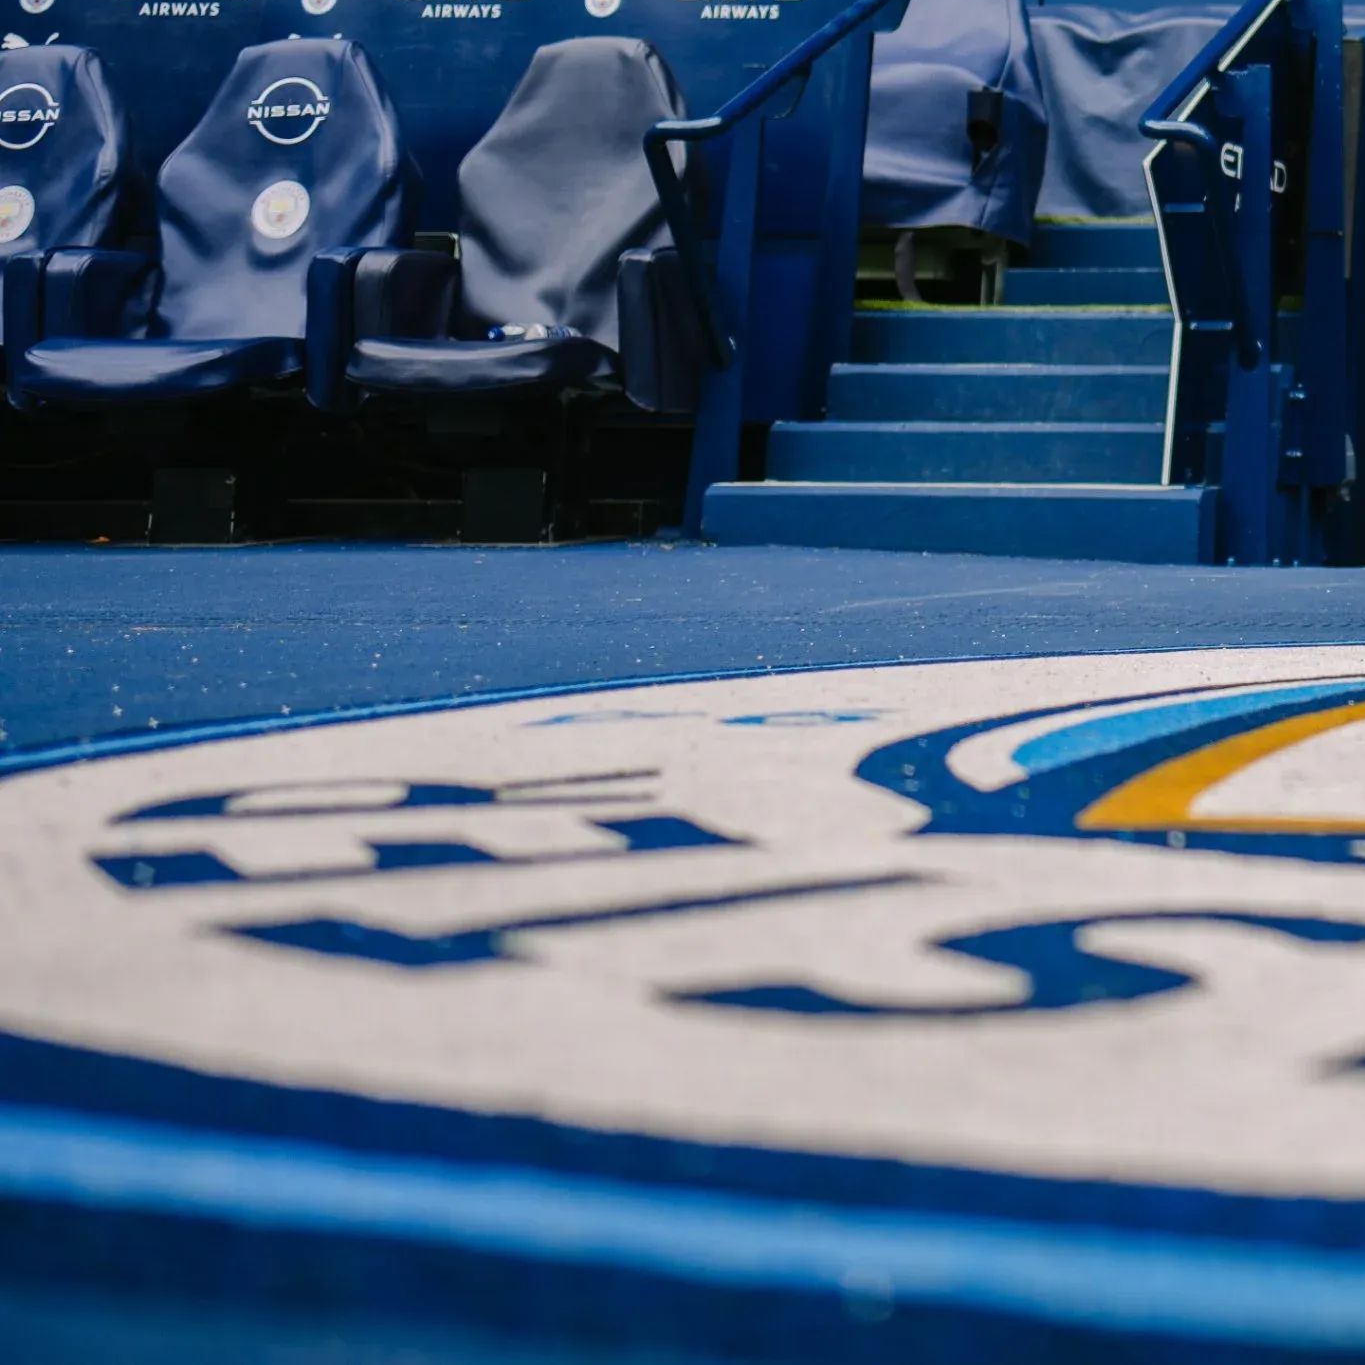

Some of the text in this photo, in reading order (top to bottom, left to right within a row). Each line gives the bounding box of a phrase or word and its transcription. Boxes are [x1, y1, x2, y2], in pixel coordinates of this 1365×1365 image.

[139, 2, 220, 17] AIRWAYS
[421, 4, 502, 19] AIRWAYS
[701, 5, 780, 19] AIRWAYS
[247, 102, 331, 119] NISSAN
